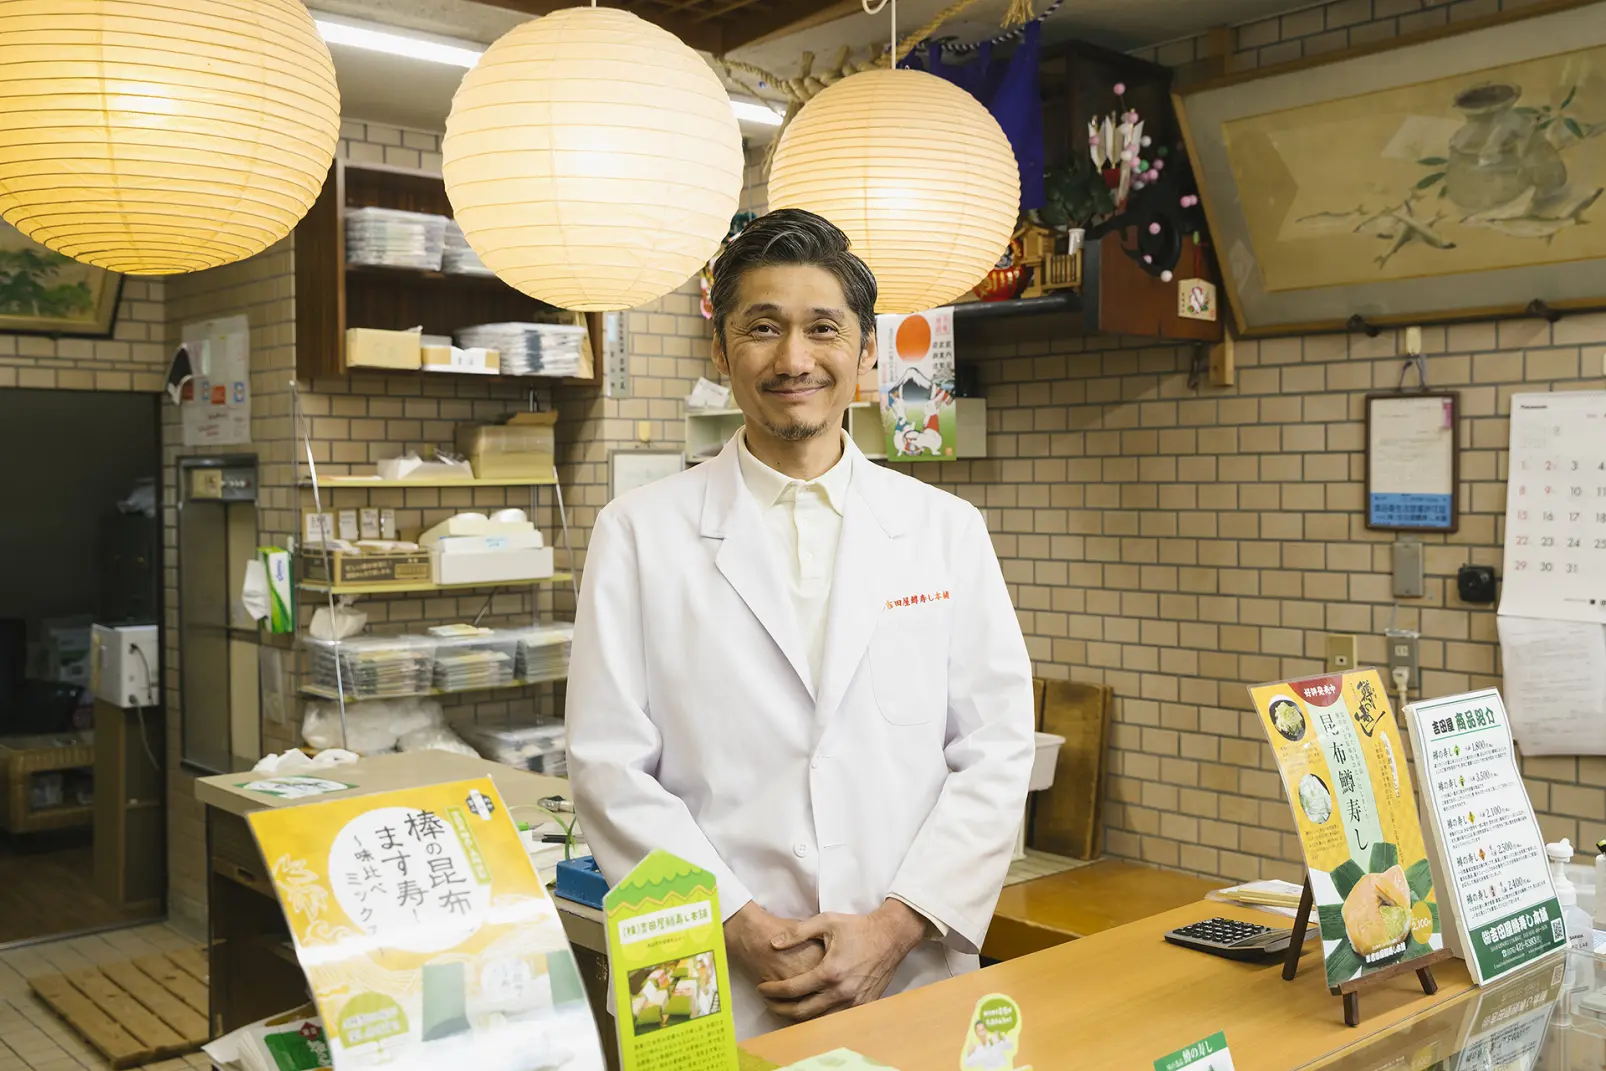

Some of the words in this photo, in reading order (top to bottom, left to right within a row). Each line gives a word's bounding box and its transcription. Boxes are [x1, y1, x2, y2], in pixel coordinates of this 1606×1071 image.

[1571, 461, 1578, 471] 3
[1598, 462, 1605, 471] 4
[1570, 487, 1582, 497] 10
[1543, 512, 1553, 521] 16
[1569, 512, 1580, 522] 17
[1516, 536, 1528, 546] 22
[1541, 537, 1553, 547] 23
[1567, 538, 1580, 548] 24
[1515, 561, 1526, 571] 29
[1540, 562, 1552, 572] 30
[1566, 563, 1578, 573] 31
[1303, 684, 1336, 698] 好評発売中
[1431, 717, 1455, 735] 吉田屋
[1455, 706, 1496, 731] 商品紹介
[1319, 713, 1369, 851] 昆布鱒寿し
[404, 809, 472, 916] 棒の昆布
